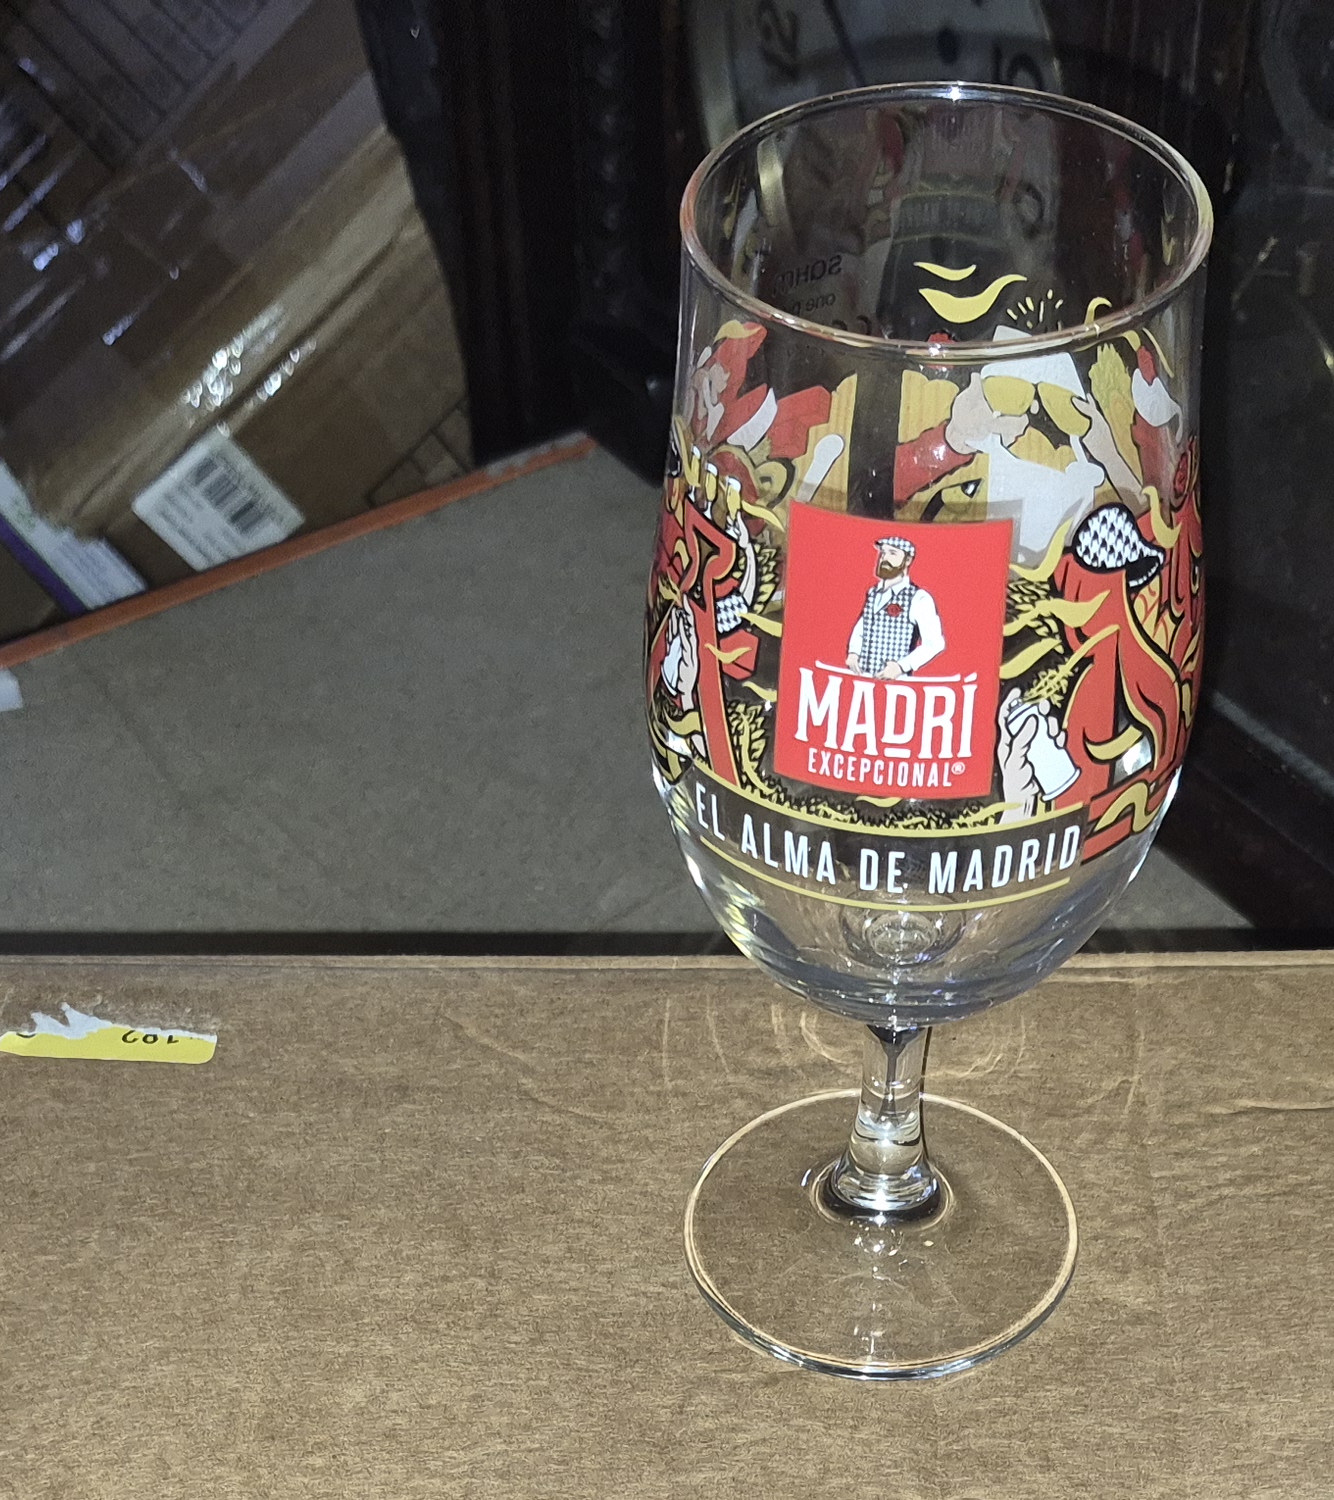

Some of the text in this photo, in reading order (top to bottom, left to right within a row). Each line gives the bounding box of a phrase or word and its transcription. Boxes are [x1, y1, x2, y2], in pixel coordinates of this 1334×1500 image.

[794, 667, 978, 759] MADRÍ
[695, 783, 1082, 894] EL ALMA DE MADRID
